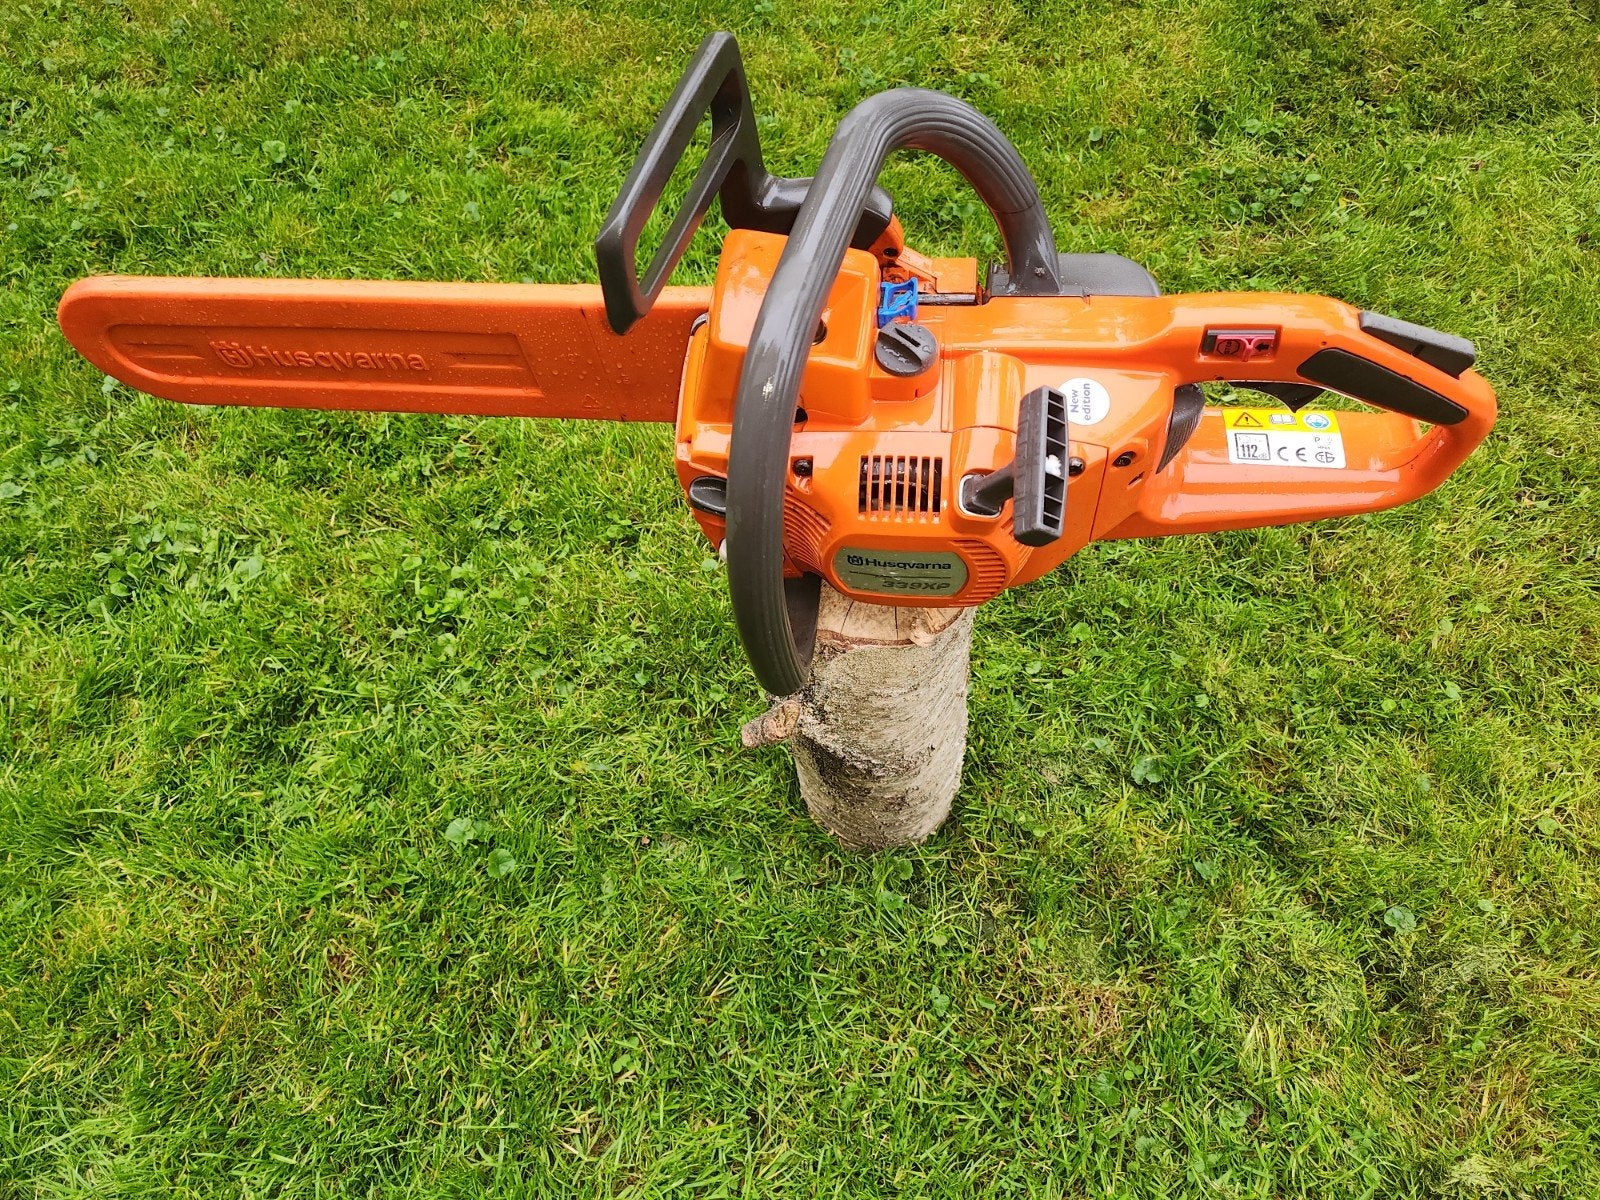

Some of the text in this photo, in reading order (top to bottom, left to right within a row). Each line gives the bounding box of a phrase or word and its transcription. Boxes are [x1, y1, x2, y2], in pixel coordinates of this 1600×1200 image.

[246, 345, 429, 371] Husqvarna
[1070, 390, 1079, 413] New
[1082, 383, 1091, 421] edition
[1240, 444, 1258, 458] 112
[866, 558, 951, 570] Husqvarna
[882, 581, 951, 590] 339XP
